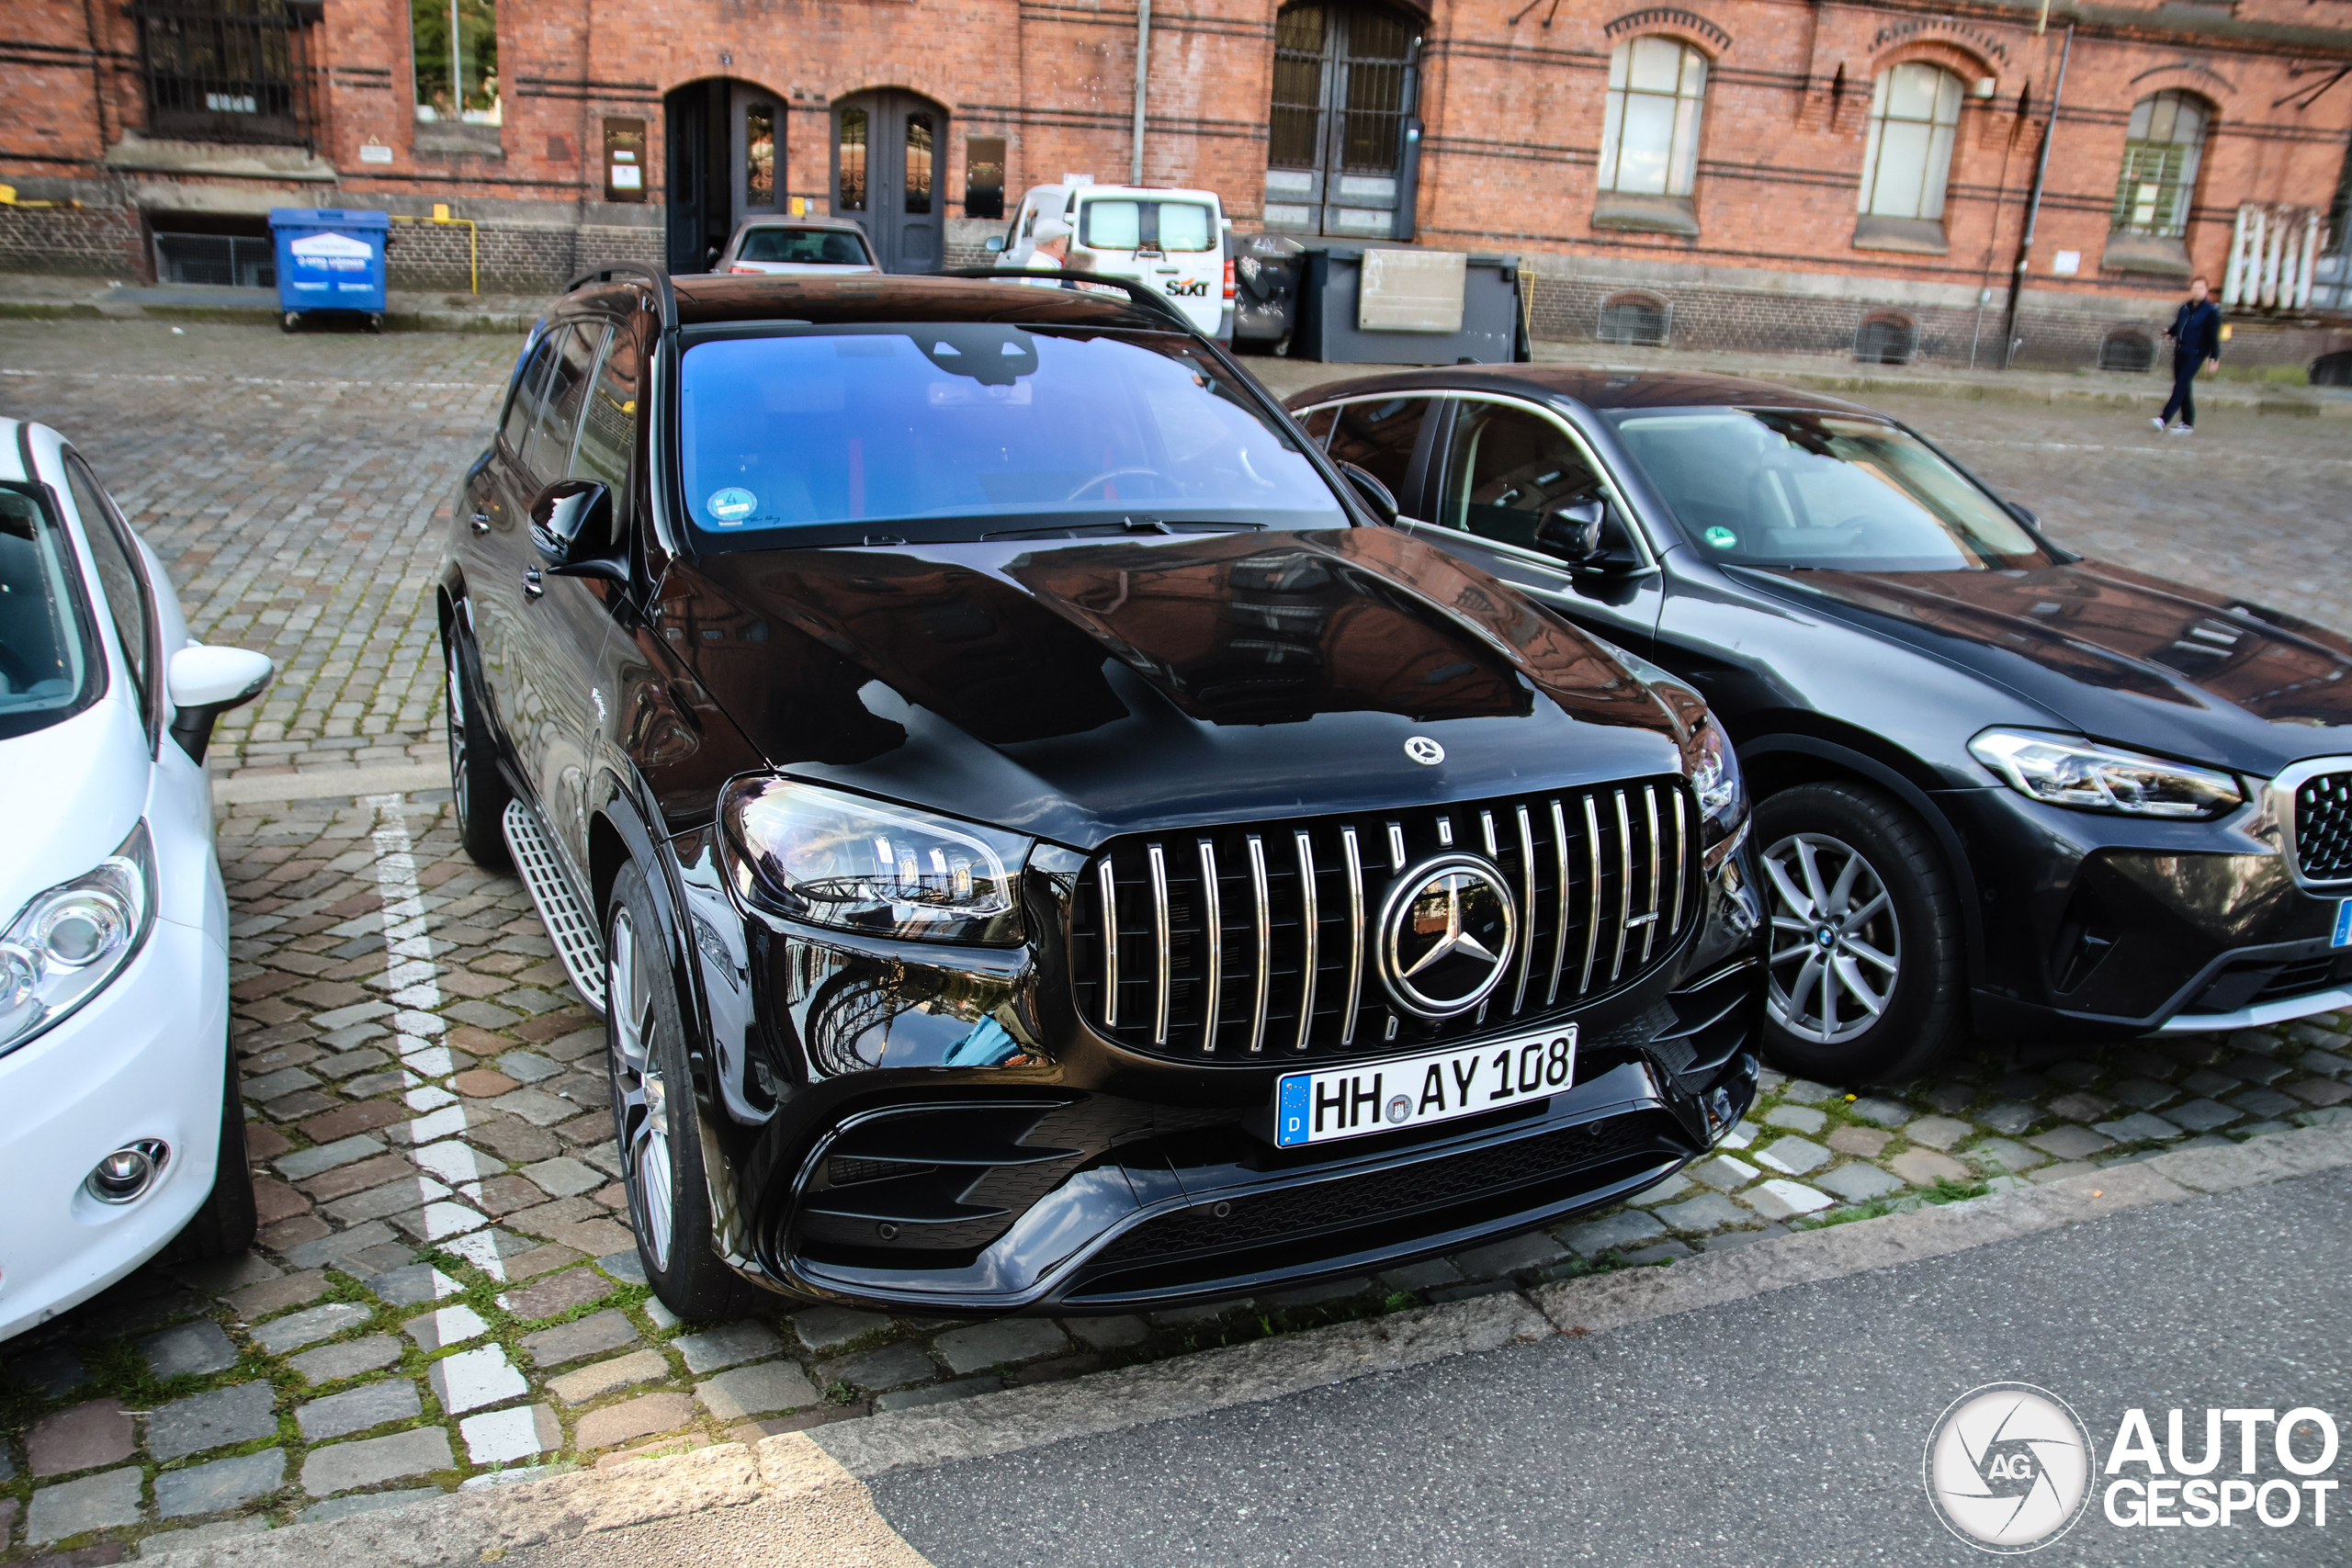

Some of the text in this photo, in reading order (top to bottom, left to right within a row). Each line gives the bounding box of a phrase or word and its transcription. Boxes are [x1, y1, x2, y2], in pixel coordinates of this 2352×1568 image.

[726, 492, 738, 504] 4
[1714, 527, 1724, 537] 4
[1315, 1037, 1570, 1133] HH AY 108
[1288, 1117, 1300, 1132] D
